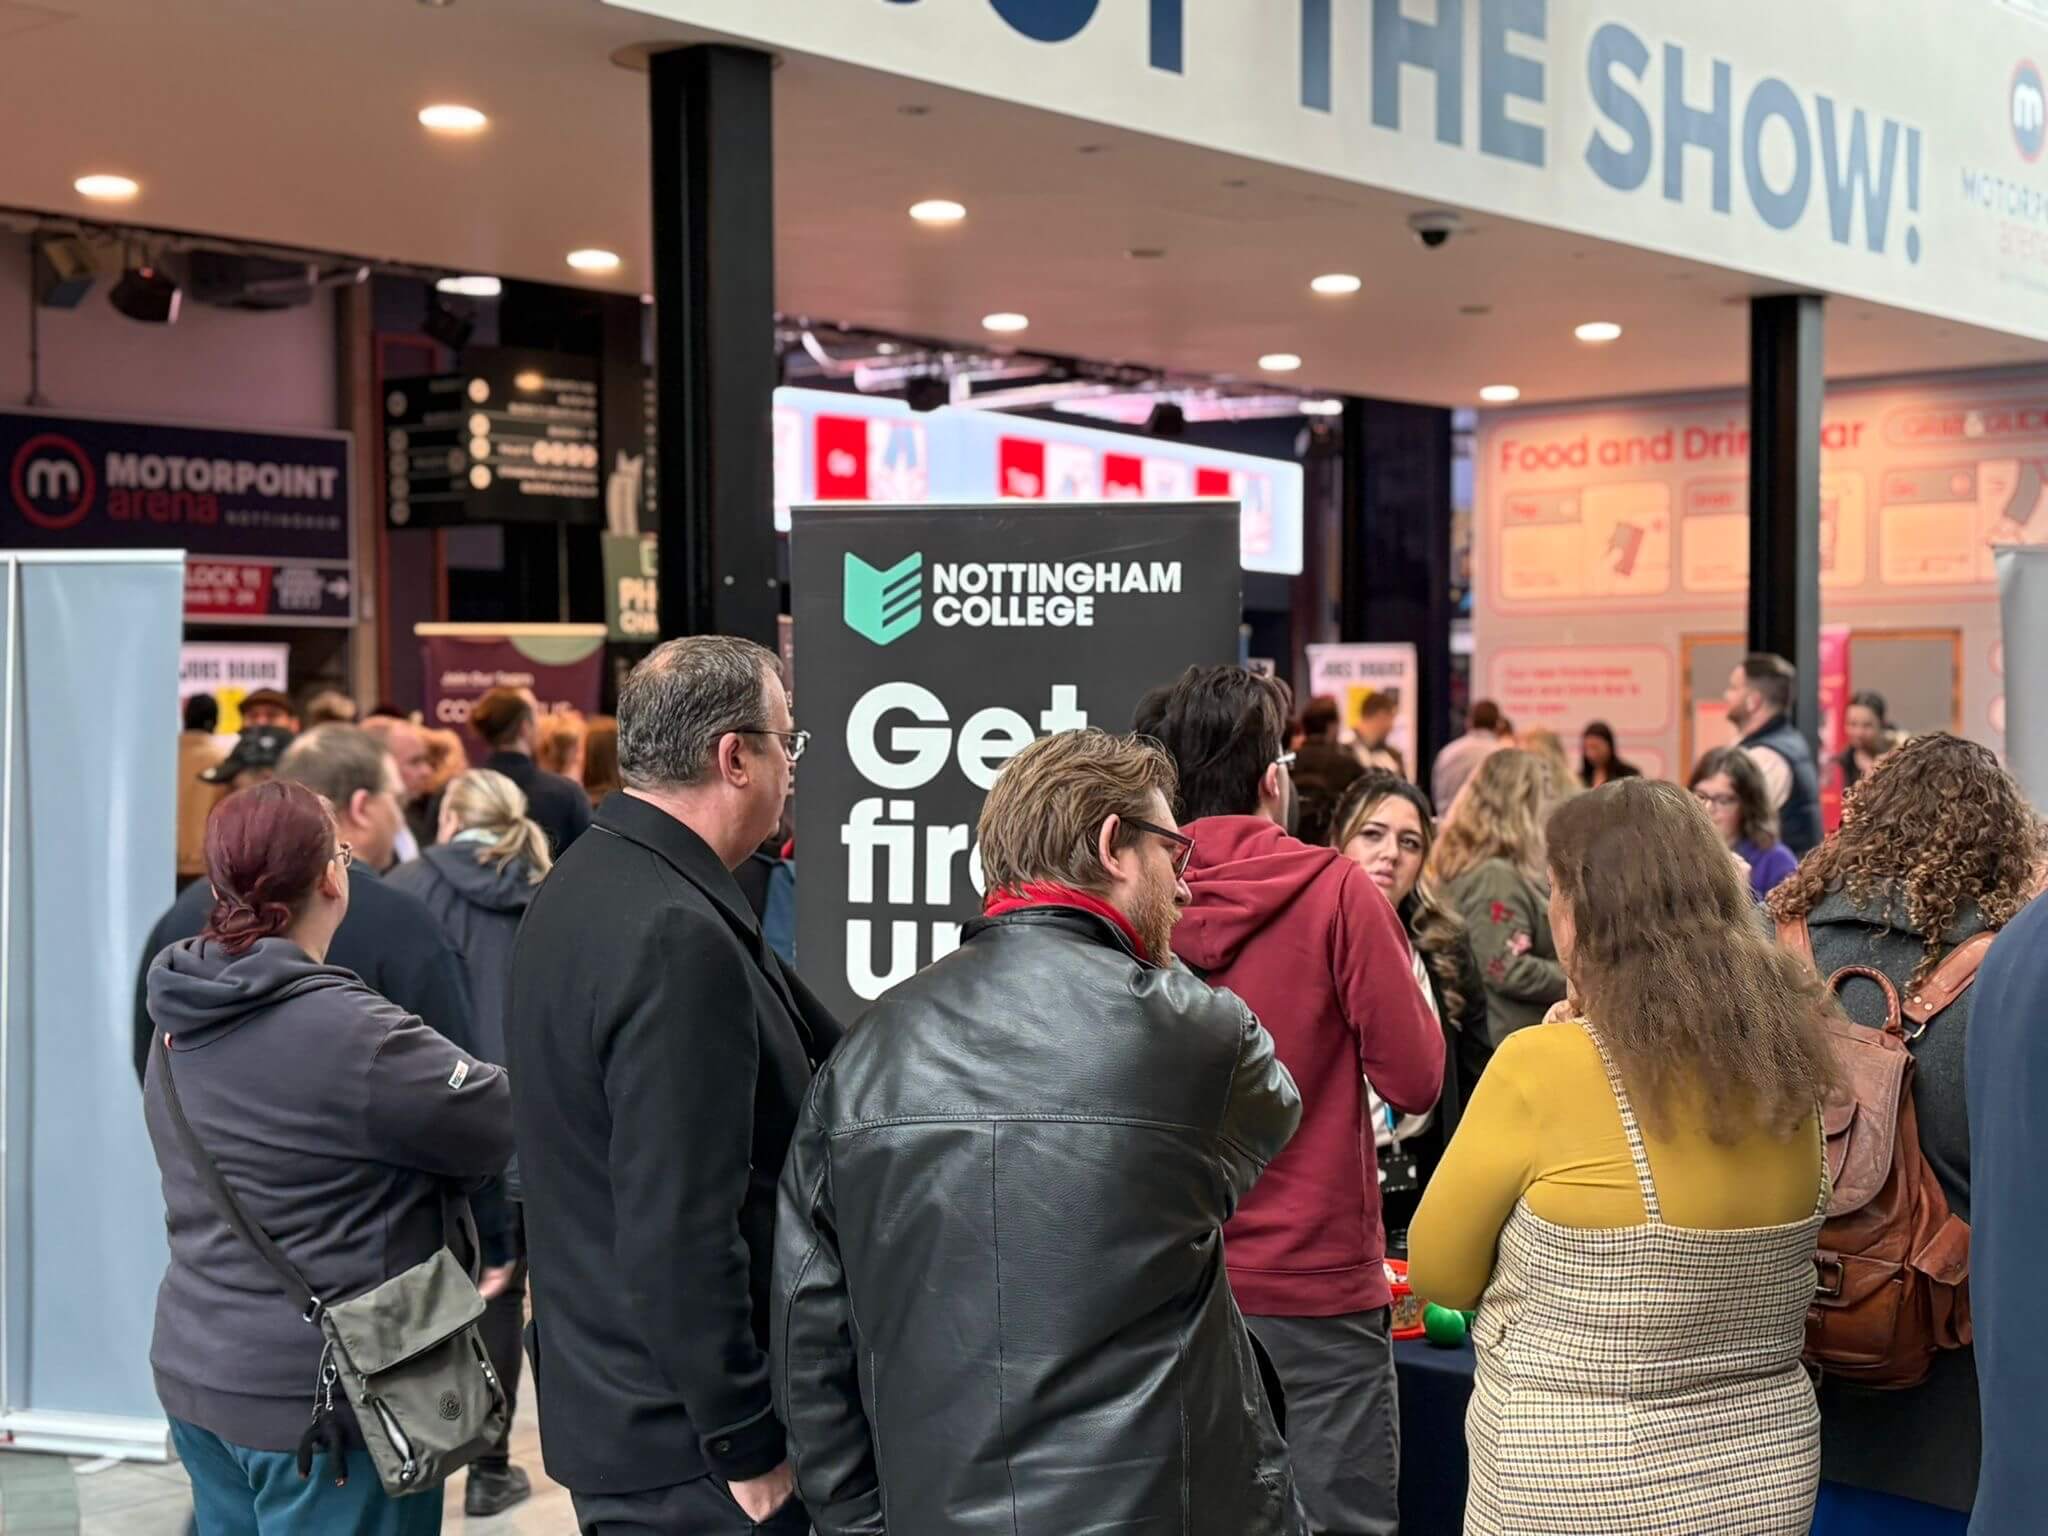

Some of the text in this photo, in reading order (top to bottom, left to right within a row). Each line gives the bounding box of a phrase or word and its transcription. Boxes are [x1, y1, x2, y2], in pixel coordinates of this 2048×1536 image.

[1584, 23, 1920, 264] SHOW!
[1502, 433, 1588, 471] Food
[1599, 431, 1673, 465] and
[1820, 422, 1866, 449] ar
[105, 452, 337, 498] MOTORPOINT
[107, 487, 218, 524] arena
[932, 562, 1182, 594] NOTTINGHAM
[932, 596, 1094, 627] COLLEGE
[846, 681, 1087, 790] Get
[841, 797, 985, 905] fir
